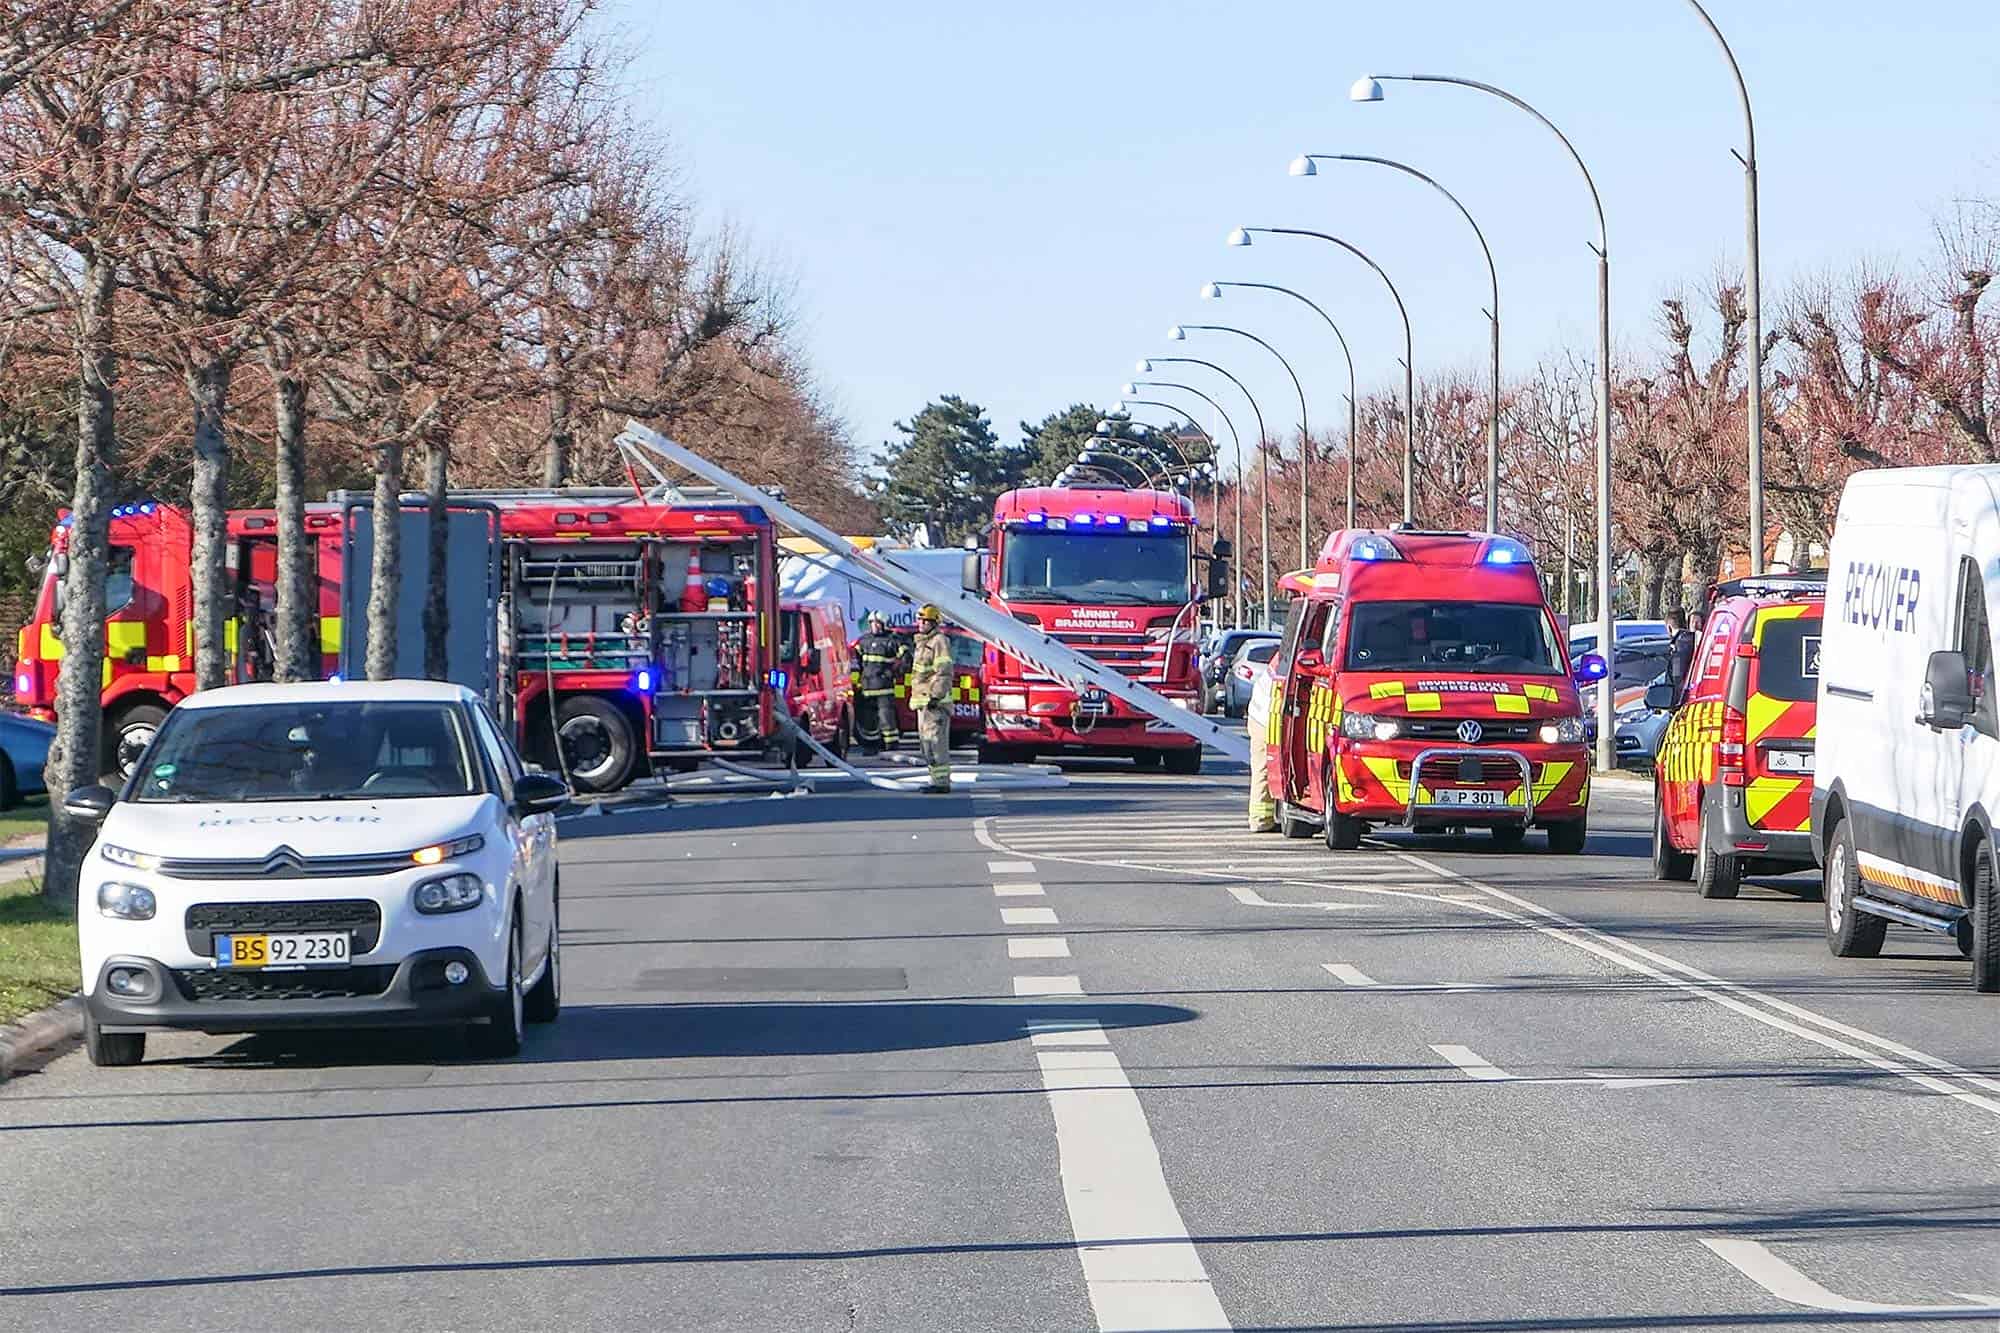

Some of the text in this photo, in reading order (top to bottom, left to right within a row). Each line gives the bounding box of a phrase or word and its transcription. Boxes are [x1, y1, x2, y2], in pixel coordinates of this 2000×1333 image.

[1842, 561, 1920, 634] RECOVER
[1071, 607, 1118, 619] TÅRNBY
[1458, 791, 1496, 805] P 301
[200, 815, 382, 828] RECOVER
[234, 940, 265, 961] BS
[271, 939, 298, 960] 92
[304, 937, 347, 959] 230
